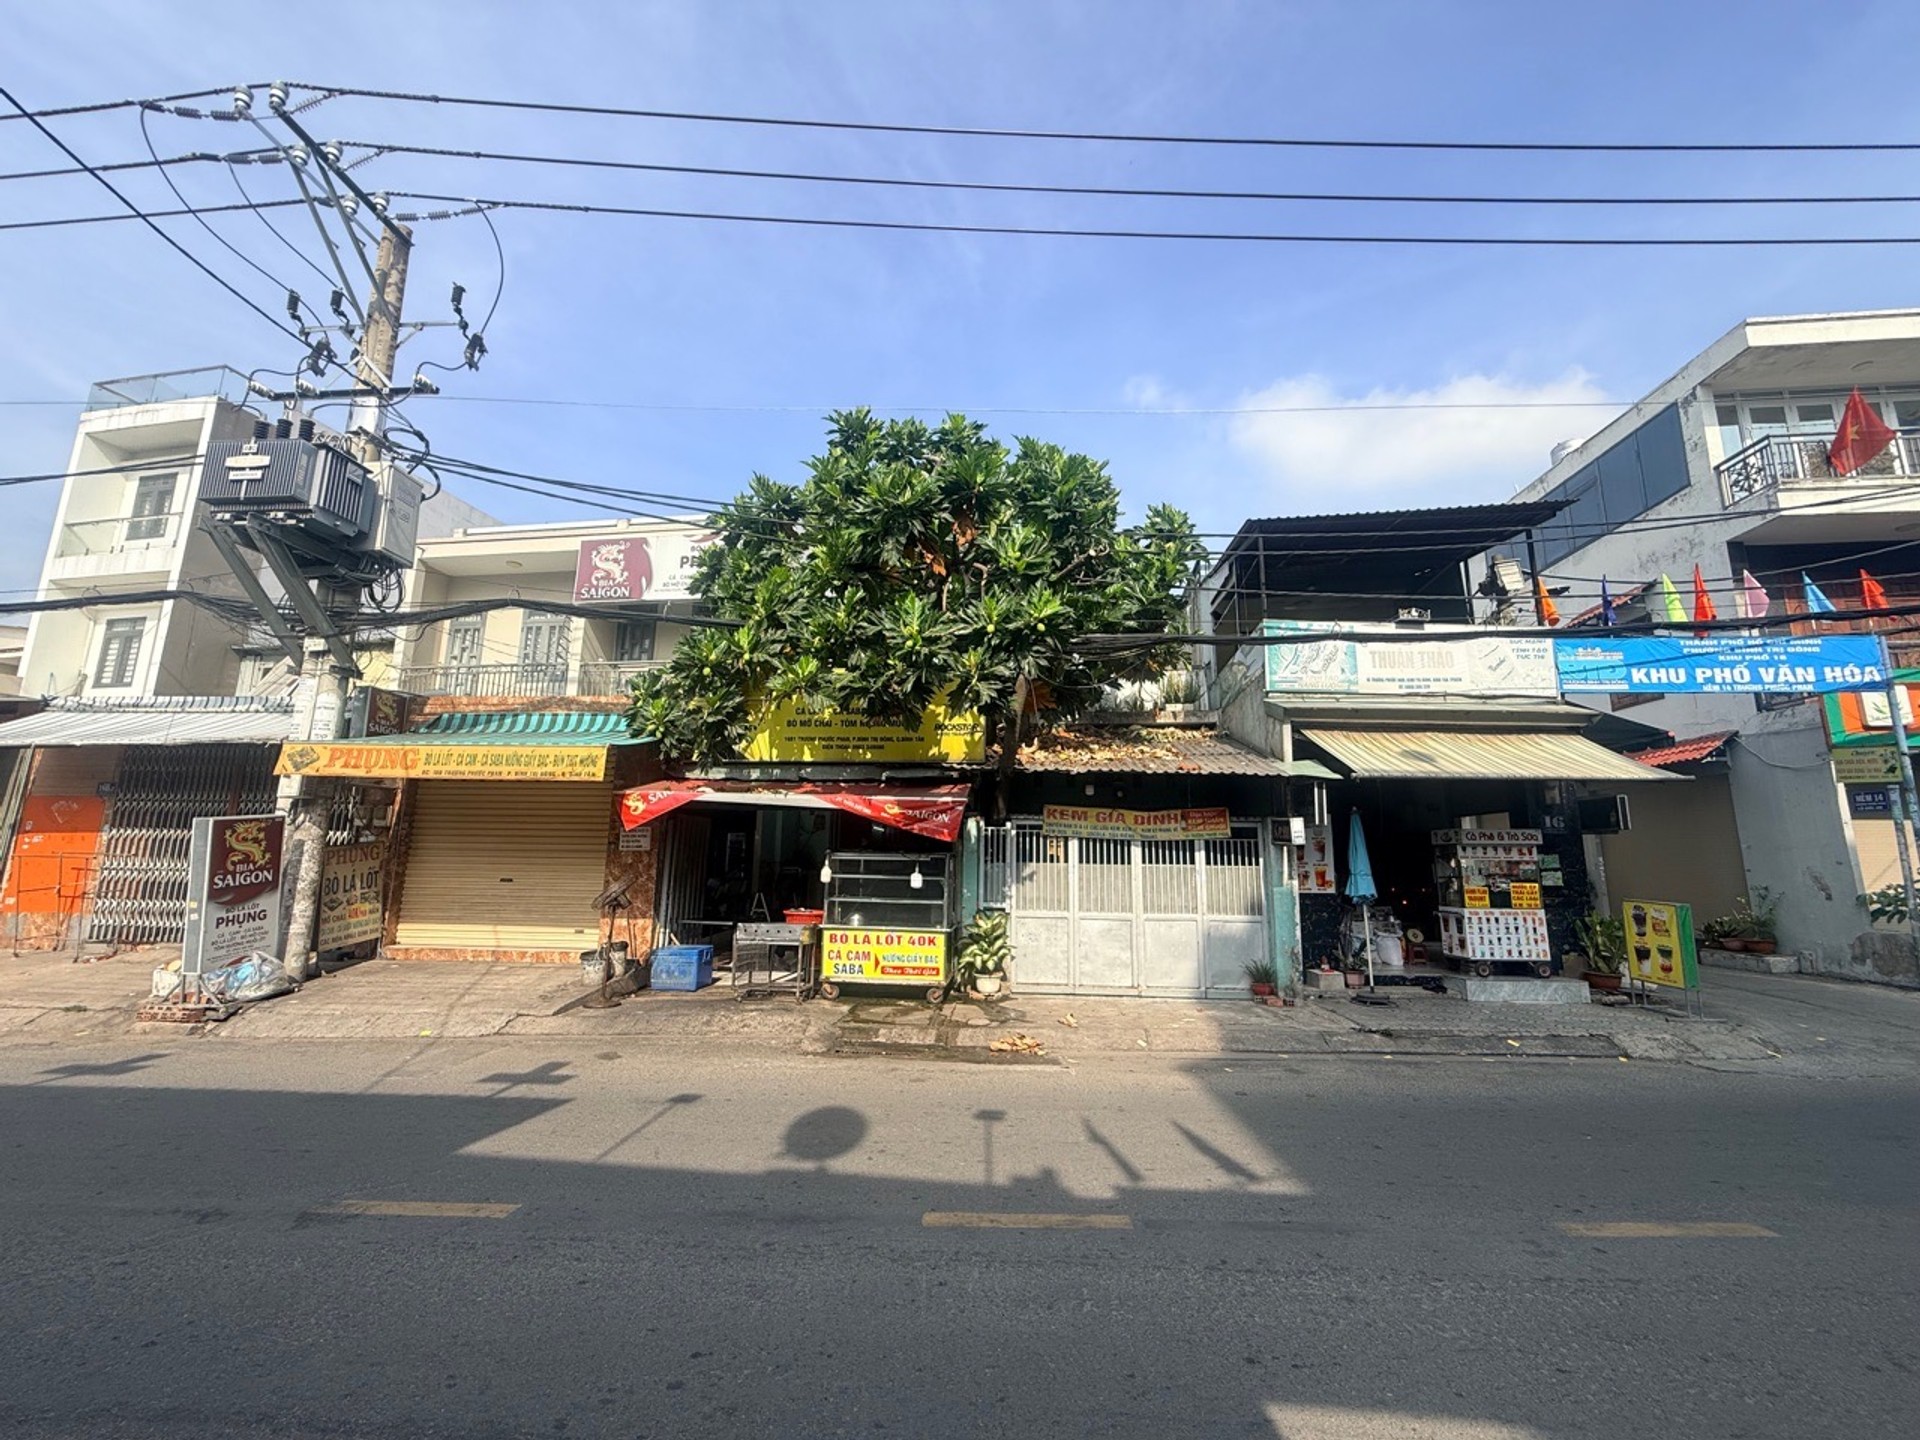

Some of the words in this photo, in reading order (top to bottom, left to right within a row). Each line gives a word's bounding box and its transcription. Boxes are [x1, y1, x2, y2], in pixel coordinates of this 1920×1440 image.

[580, 586, 630, 599] SAIGON
[1631, 668, 1687, 684] KHU
[1695, 663, 1751, 684] PHỐ
[1758, 664, 1816, 684] VĂN
[1823, 663, 1882, 683] HÓA
[934, 722, 979, 732] ROCKSTAR
[324, 747, 421, 774] PHỤNG
[1046, 808, 1088, 821] KEM
[1544, 815, 1566, 828] 16
[1465, 831, 1477, 841] Cà
[1478, 831, 1495, 841] Phê
[235, 864, 255, 873] BIA
[213, 869, 274, 889] SAIGON
[324, 871, 339, 896] BÒ
[343, 868, 356, 893] LÁ
[360, 866, 380, 890] LỐT
[215, 909, 268, 929] PHỤNG
[908, 935, 937, 947] 40K
[846, 950, 871, 961] CAM
[833, 963, 864, 975] SABA
